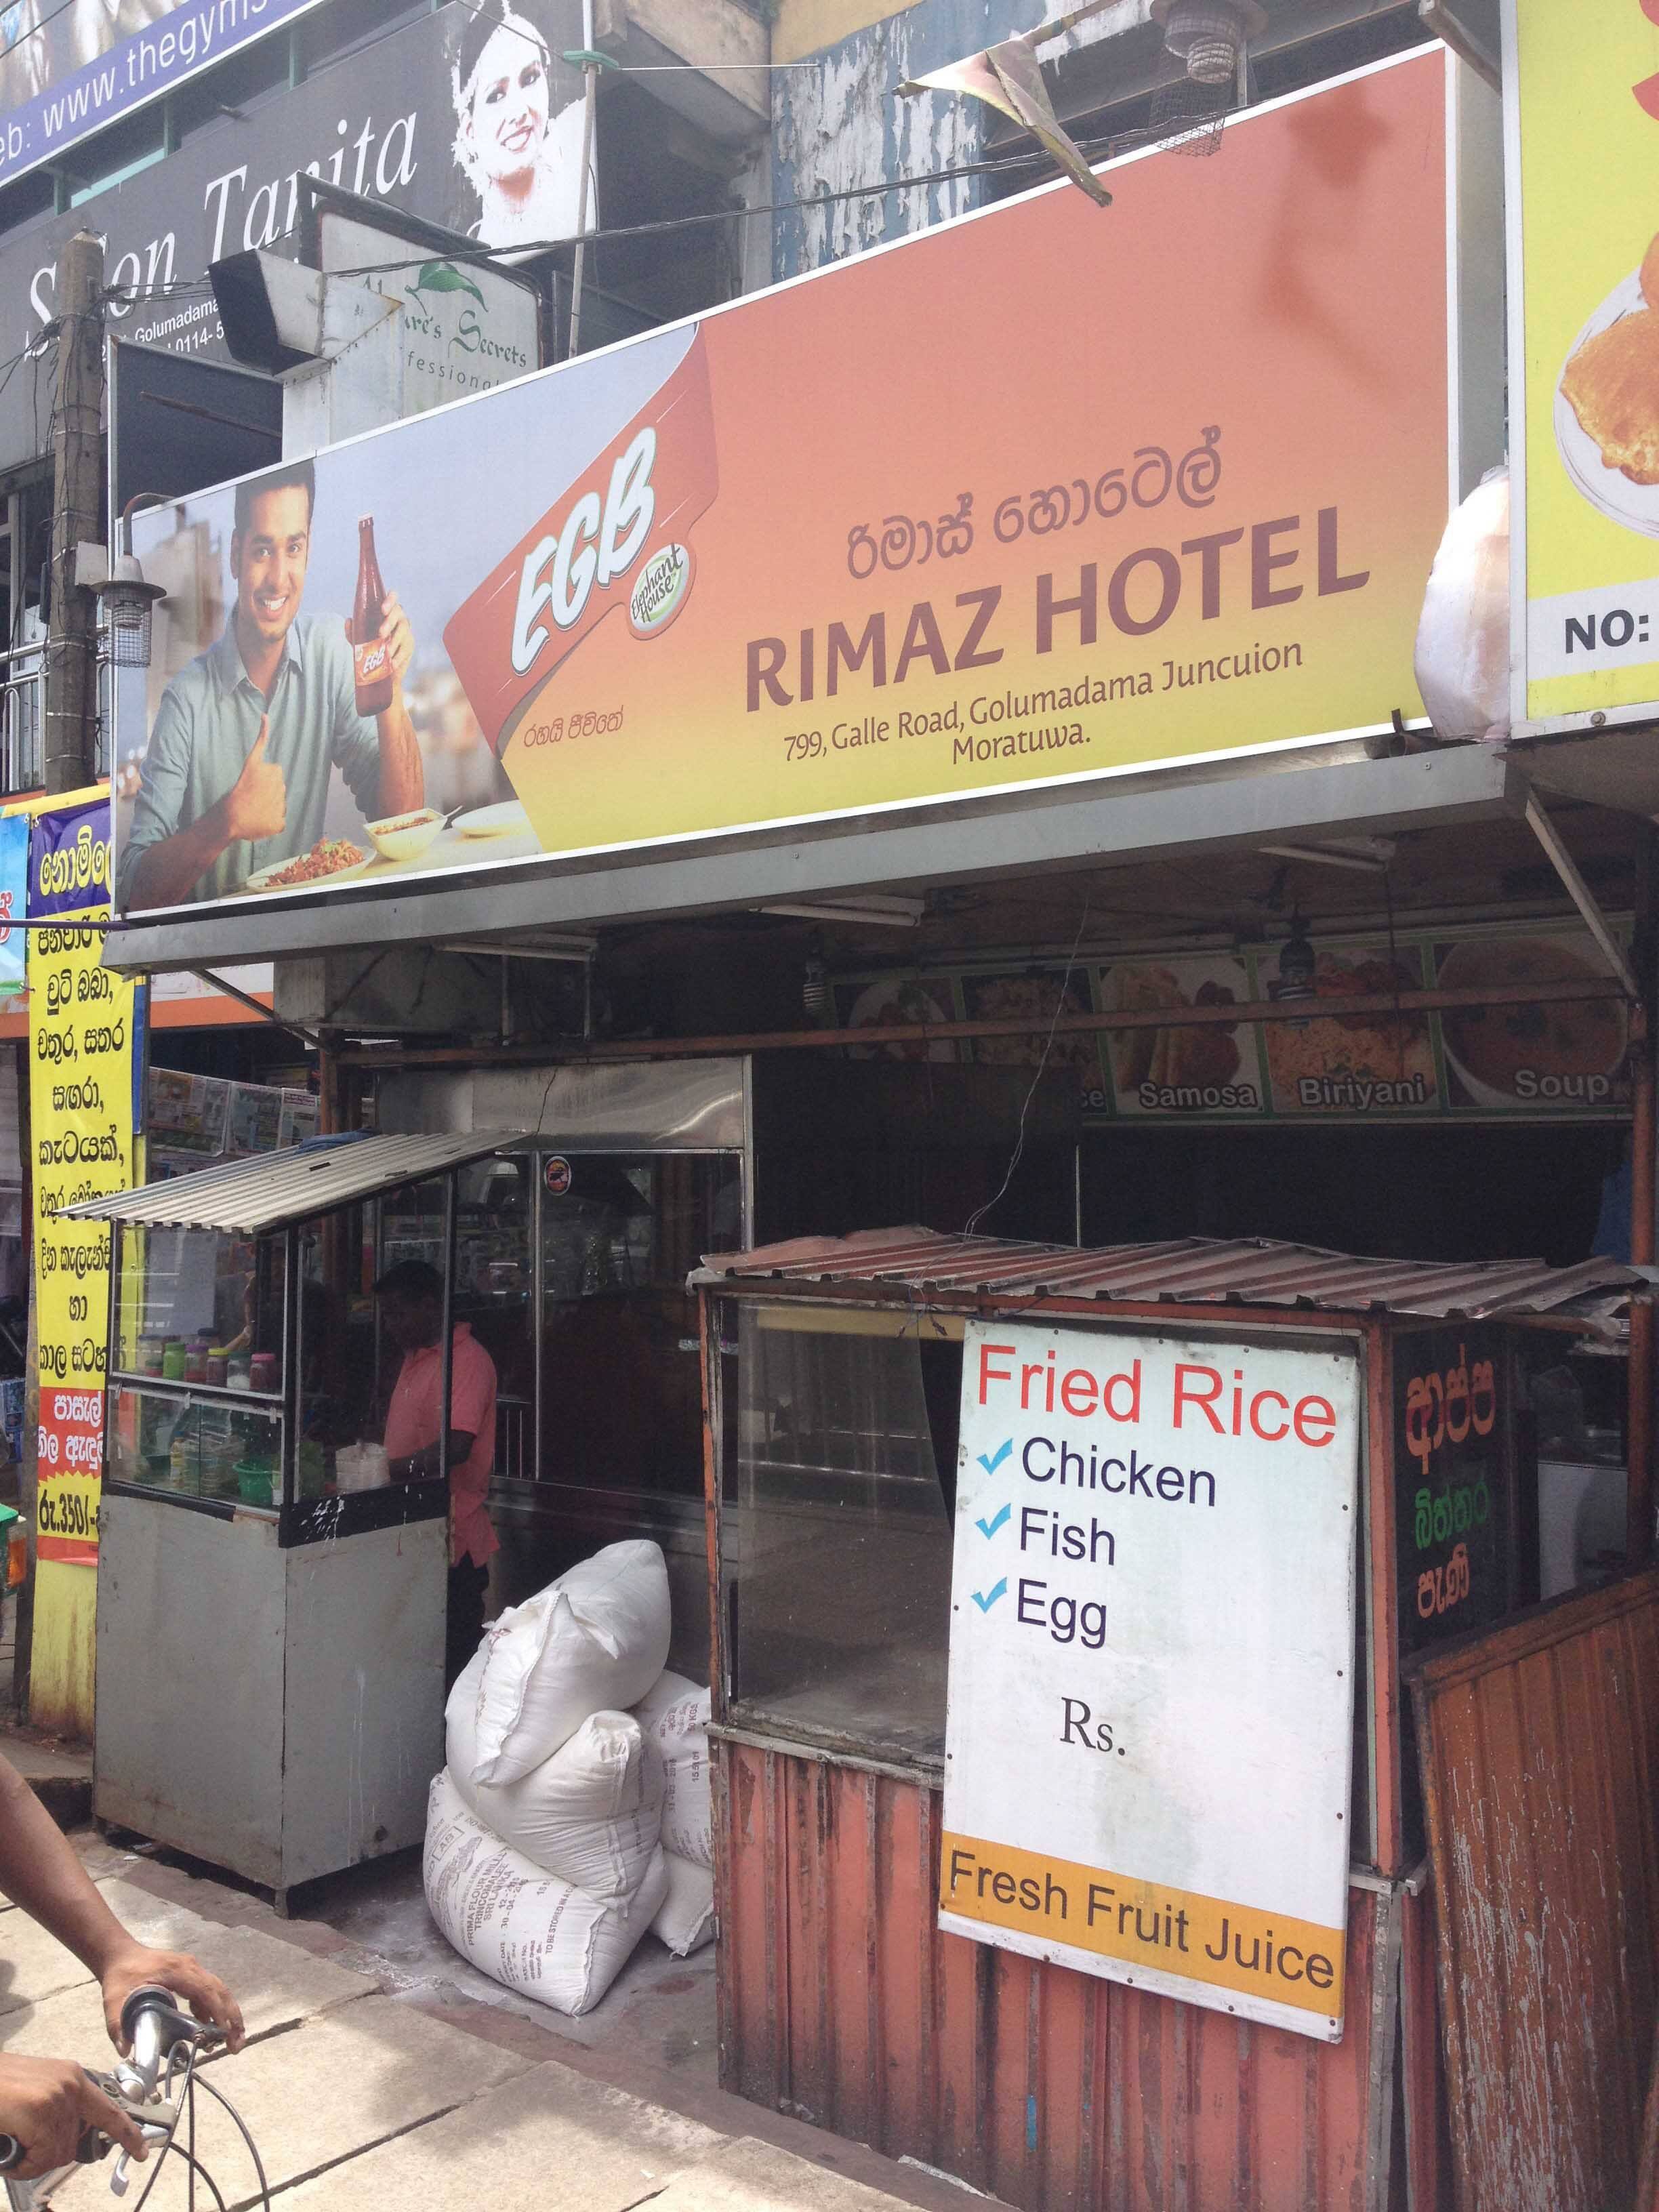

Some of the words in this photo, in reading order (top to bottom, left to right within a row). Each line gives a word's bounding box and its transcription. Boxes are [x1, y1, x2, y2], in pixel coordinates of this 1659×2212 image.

[448, 310, 527, 368] Secrets
[511, 426, 657, 676] EGB
[632, 543, 683, 619] Elephant
[641, 575, 674, 623] House
[747, 584, 1004, 712] RIMAZ
[1036, 506, 1370, 655] HOTEL
[1565, 609, 1649, 654] NO:
[1162, 642, 1303, 692] Juncuion
[954, 721, 1090, 765] Moratuwa.
[1139, 1081, 1258, 1109] Samosa
[1299, 1073, 1425, 1110] Biriyani
[1513, 1069, 1610, 1101] Soup
[978, 1343, 1142, 1423] Fried
[1173, 1362, 1337, 1448] Rice
[1021, 1436, 1216, 1507] Chicken
[1020, 1506, 1115, 1566] Fish
[1017, 1577, 1107, 1650] Egg
[1059, 1696, 1126, 1756] Rs.
[469, 1877, 485, 1911] FLOUR
[483, 1903, 495, 1921] SRI
[548, 1905, 565, 1933] STORED
[950, 1849, 1068, 1919] Fresh
[1087, 1883, 1189, 1952] Fruit
[1205, 1918, 1334, 1988] Juice
[467, 1912, 475, 1946] PRIMA
